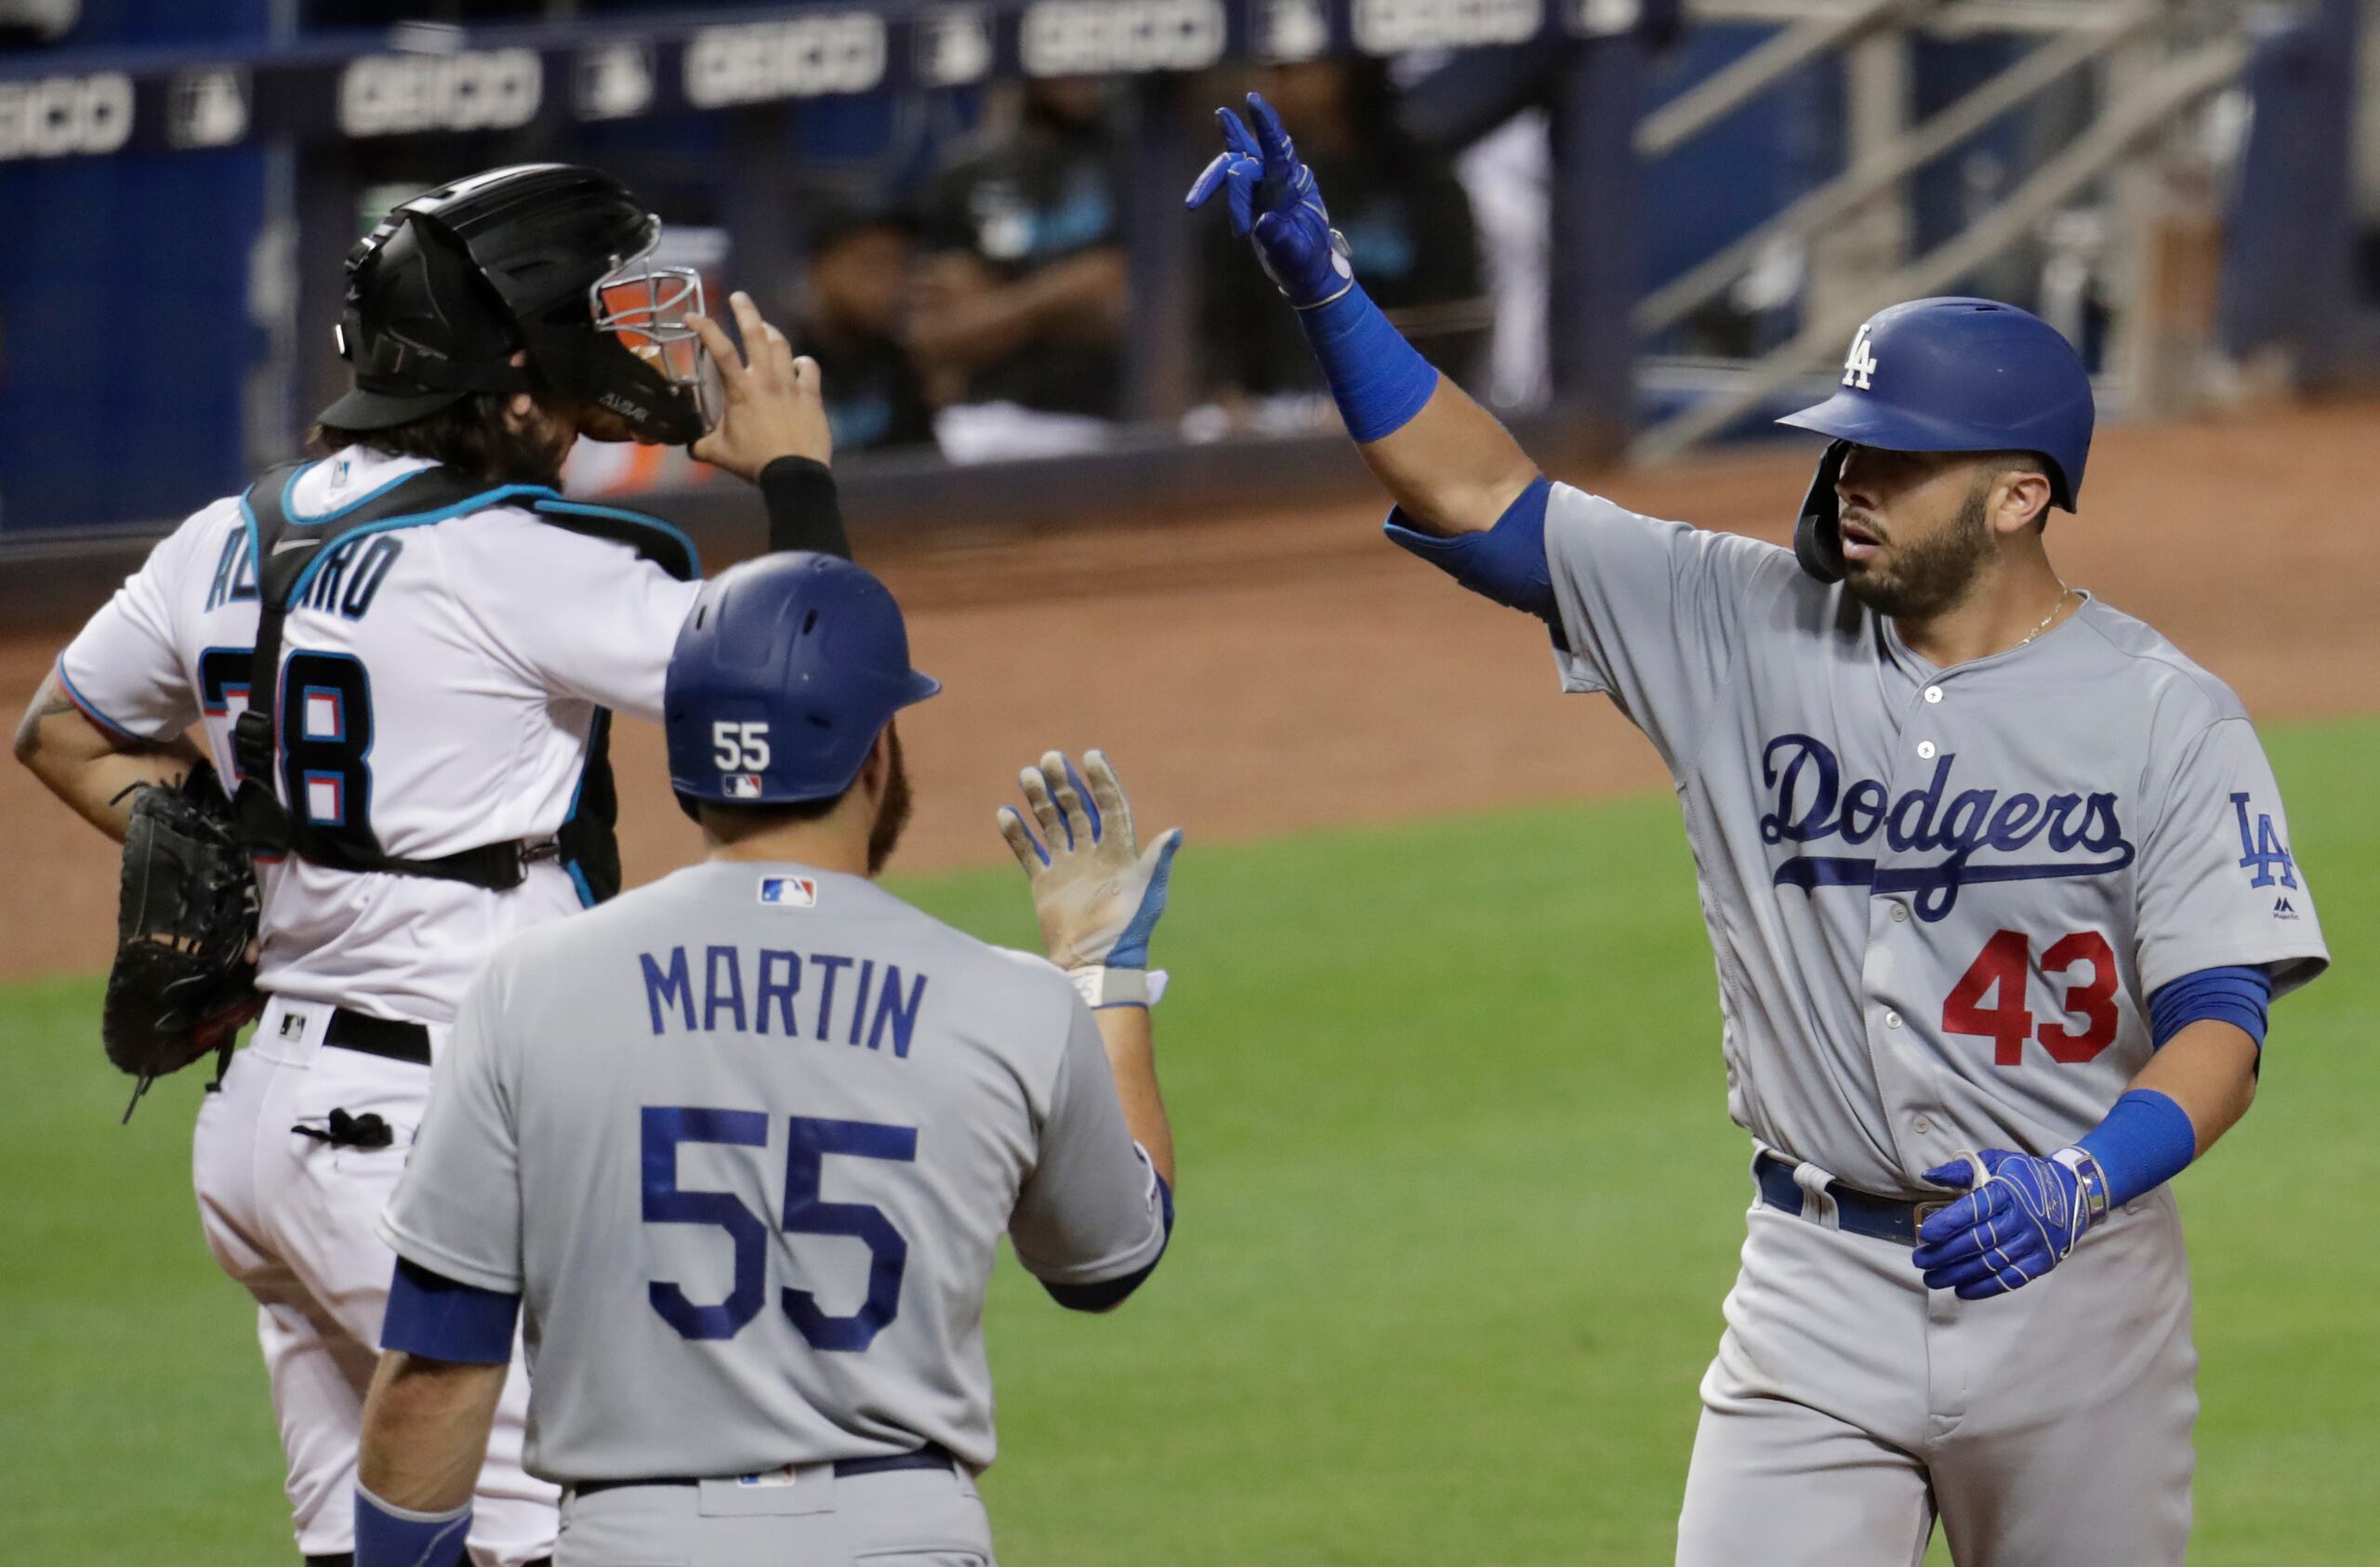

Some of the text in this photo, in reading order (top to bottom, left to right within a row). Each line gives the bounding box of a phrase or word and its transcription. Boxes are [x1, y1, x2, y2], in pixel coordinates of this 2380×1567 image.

[681, 12, 886, 110] GEICO
[1019, 0, 1224, 78] GEICO
[337, 48, 543, 137] GEICO
[1842, 323, 1877, 390] LA
[204, 523, 403, 623] ALRO
[713, 720, 771, 771] 55
[1762, 733, 2135, 923] Dodgers
[2229, 792, 2297, 890] LA
[639, 944, 928, 1059] MARTIN
[1942, 929, 2120, 1066] 43
[641, 1105, 919, 1352] 55
